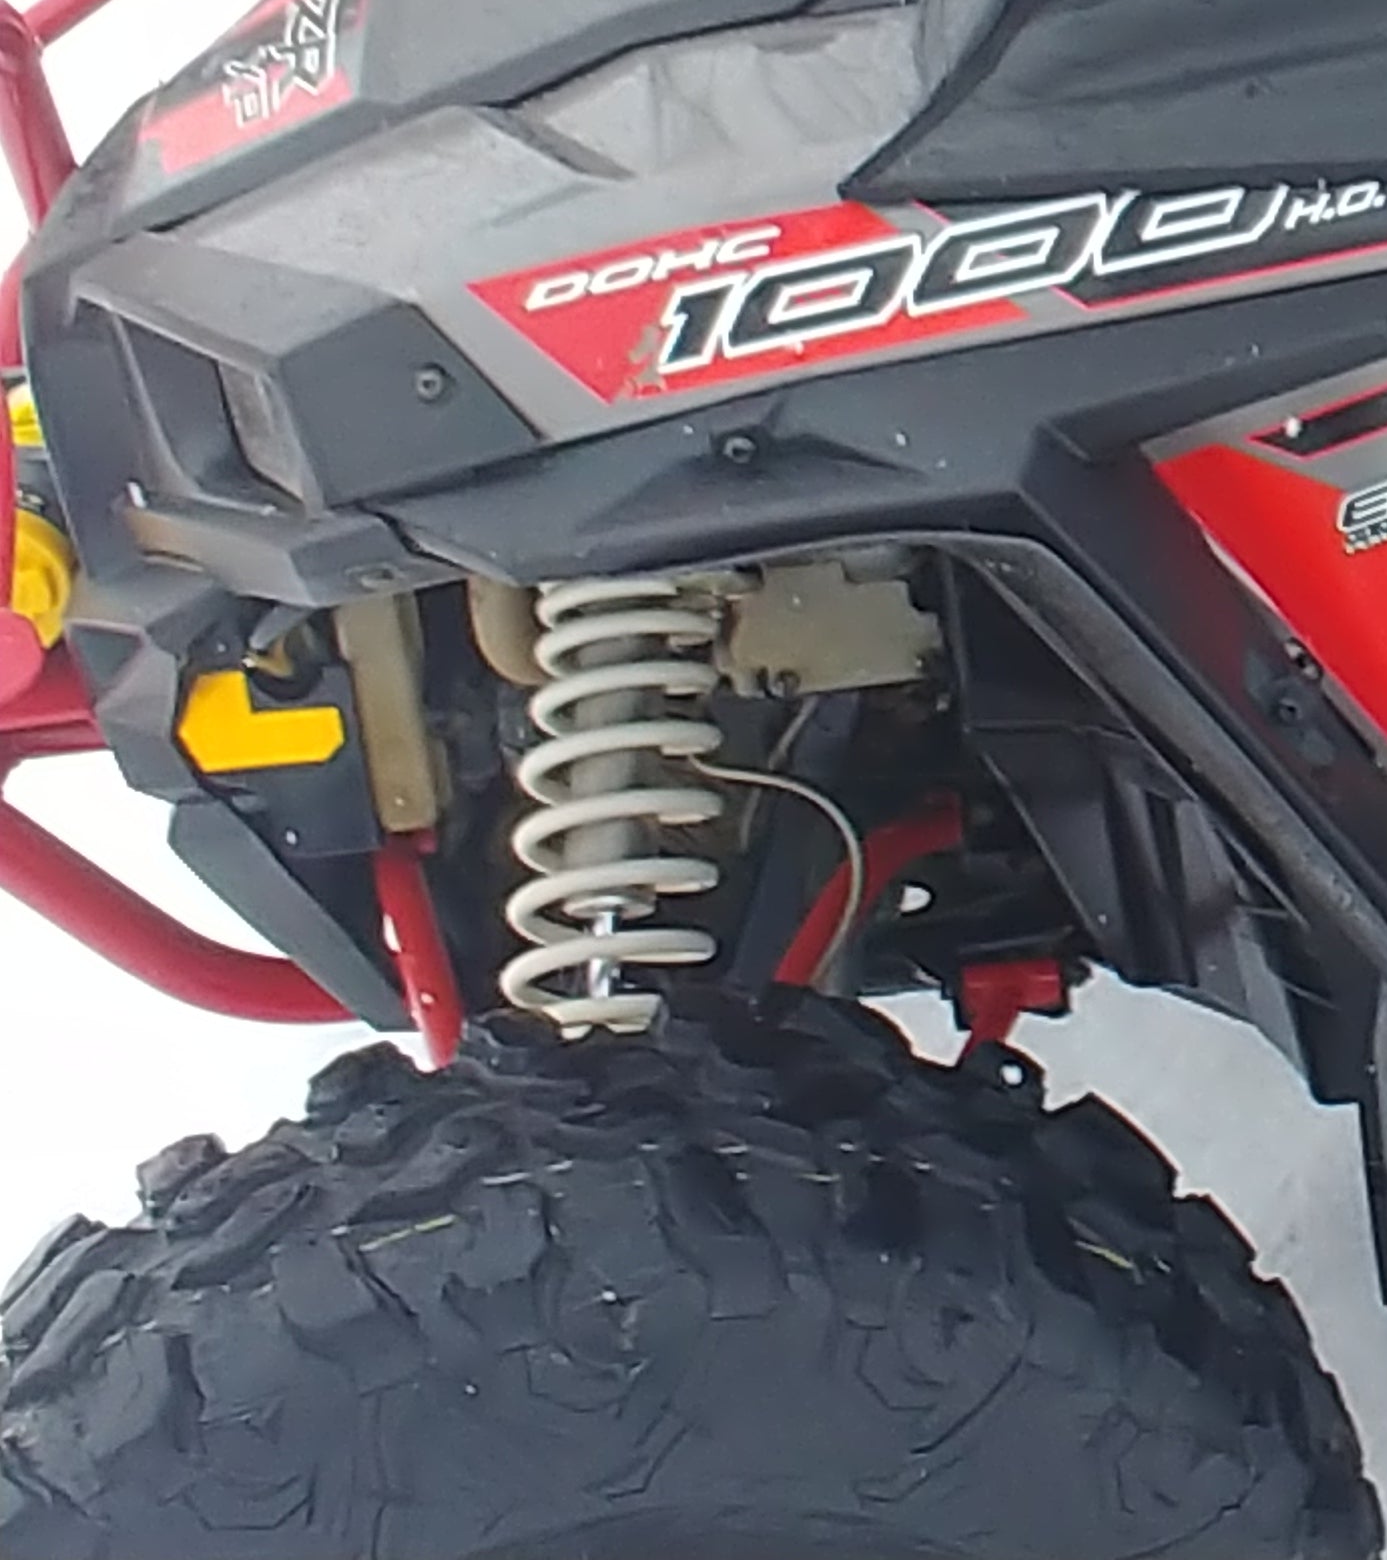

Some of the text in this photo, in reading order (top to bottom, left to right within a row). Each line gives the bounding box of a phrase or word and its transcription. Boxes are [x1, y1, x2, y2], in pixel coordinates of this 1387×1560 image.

[525, 225, 781, 311] DOHC
[657, 180, 1387, 374] 1000 H.O.
